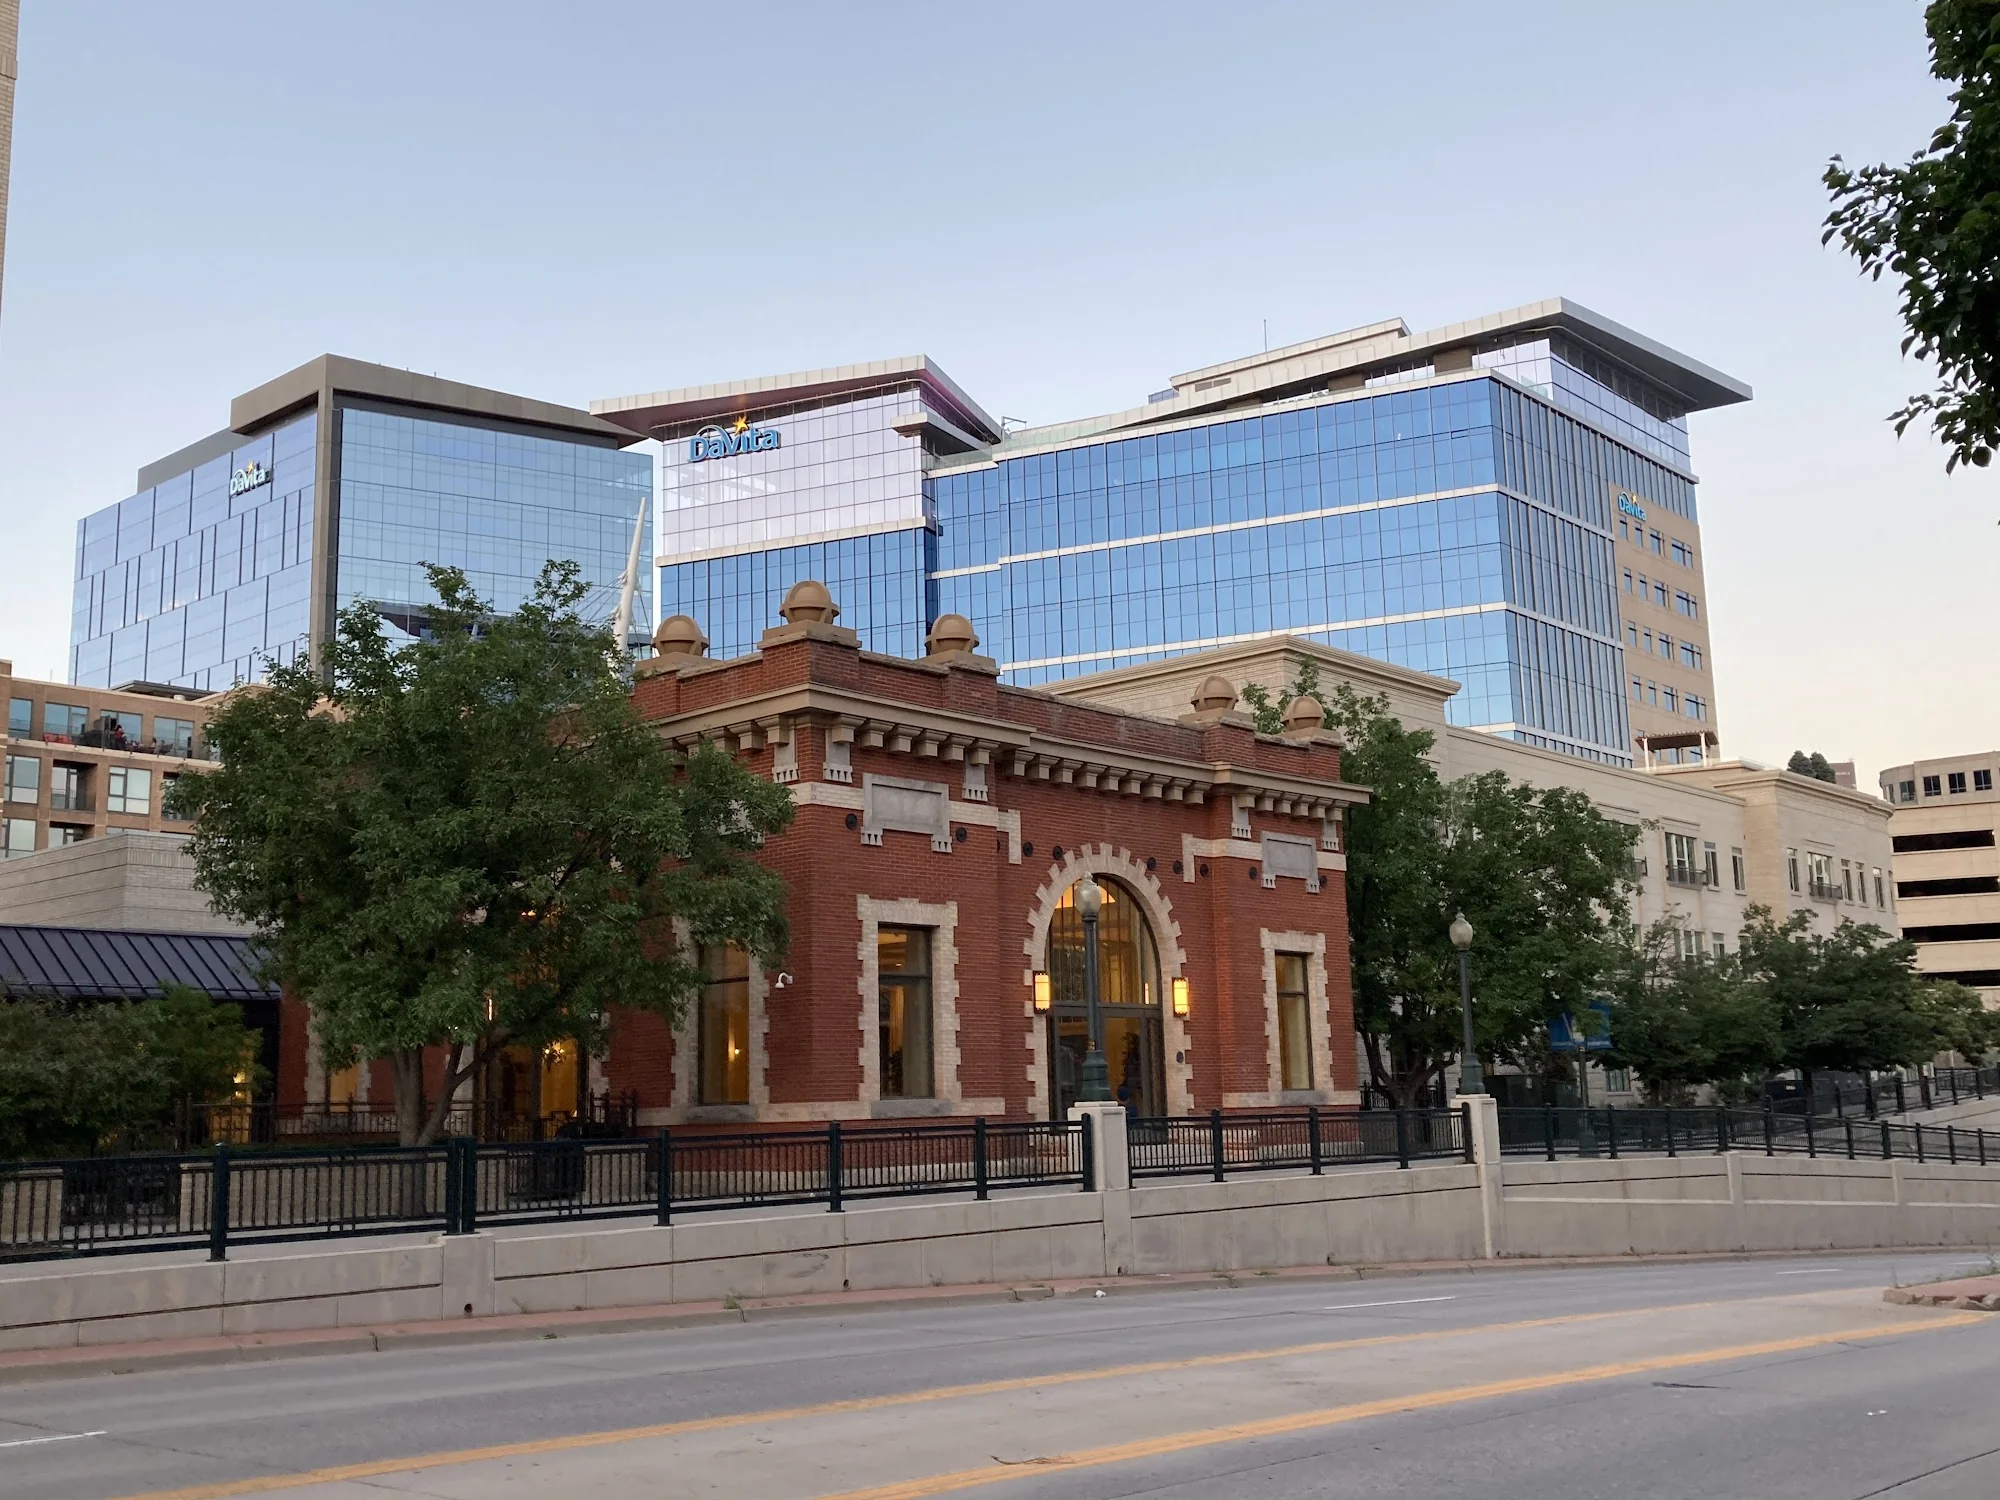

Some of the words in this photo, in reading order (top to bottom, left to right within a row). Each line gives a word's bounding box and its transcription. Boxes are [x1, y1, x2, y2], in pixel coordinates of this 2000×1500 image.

[689, 424, 780, 462] DaVita
[229, 468, 266, 495] DaVita
[1618, 492, 1647, 521] DaVita
